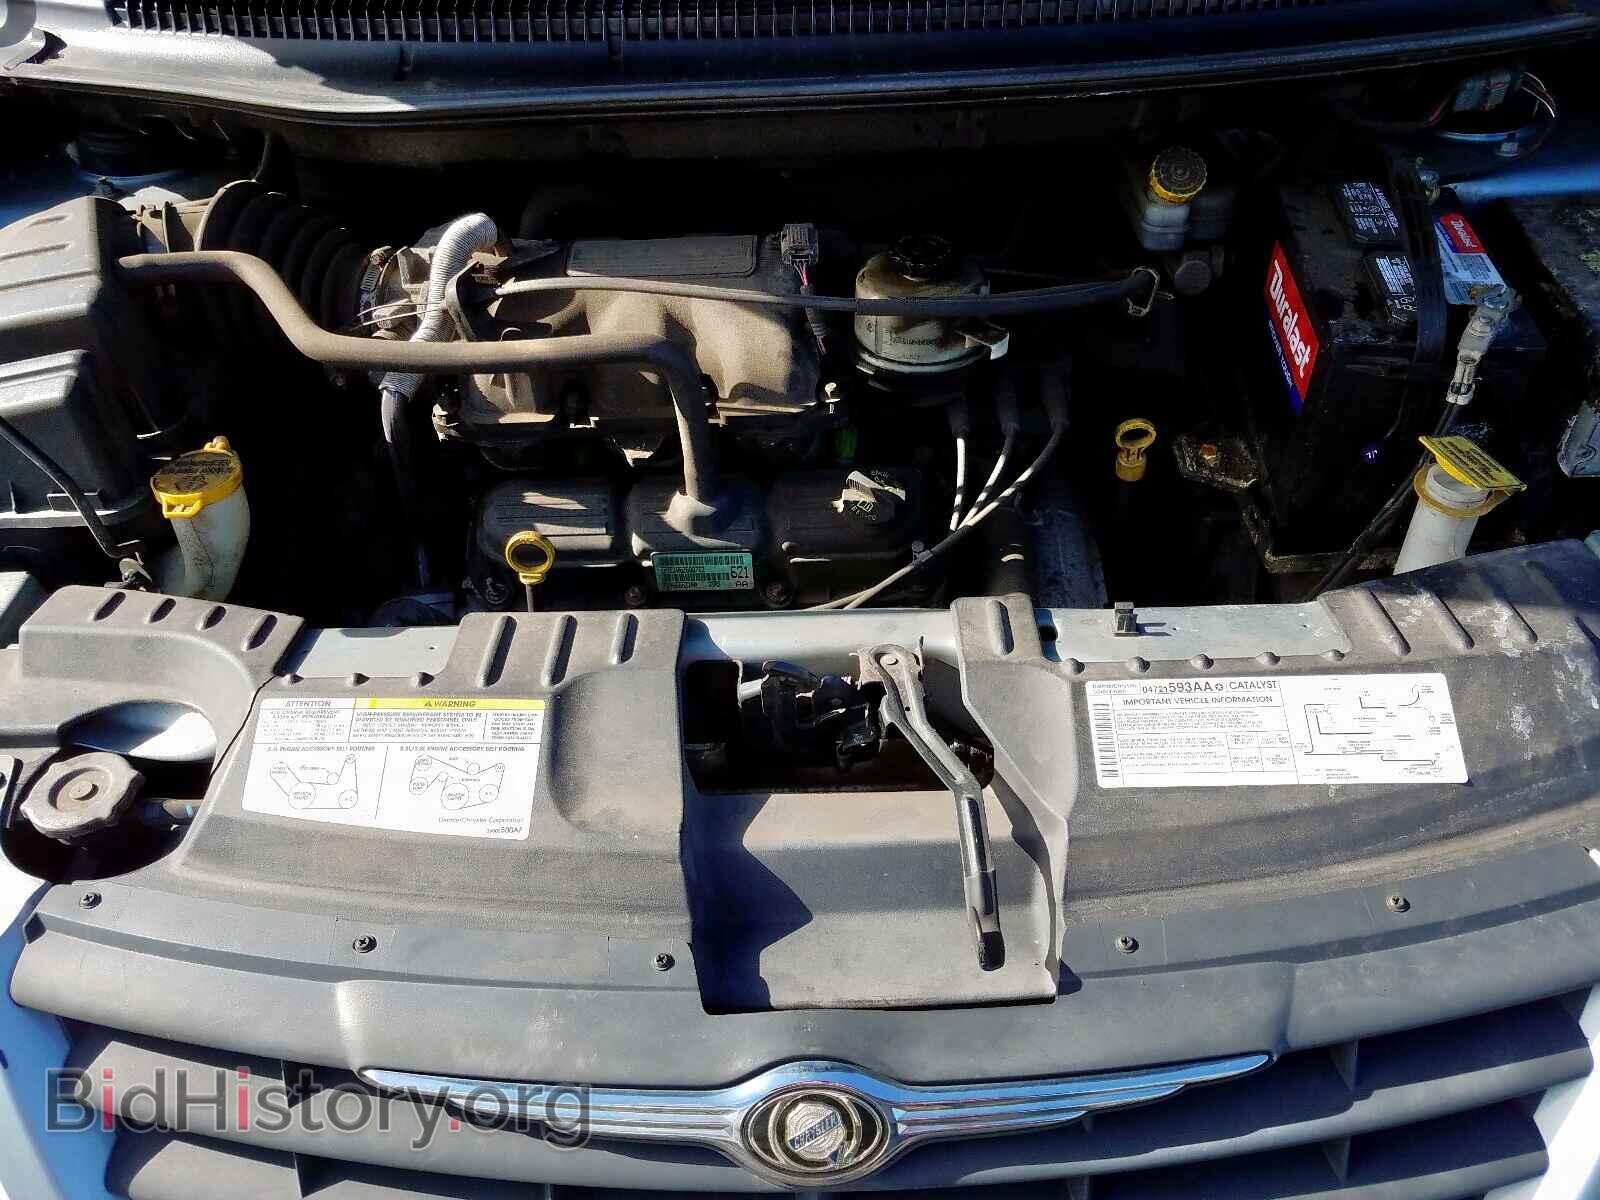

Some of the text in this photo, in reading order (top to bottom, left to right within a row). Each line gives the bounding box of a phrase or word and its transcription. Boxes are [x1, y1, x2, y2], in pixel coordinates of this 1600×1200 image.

[1268, 259, 1311, 380] Duralast
[1228, 680, 1277, 690] CATALYST
[285, 700, 332, 708] ATTENTION
[434, 700, 476, 708] WARNING
[1122, 695, 1273, 706] IMPORTANT VEHICLE INFORMATION
